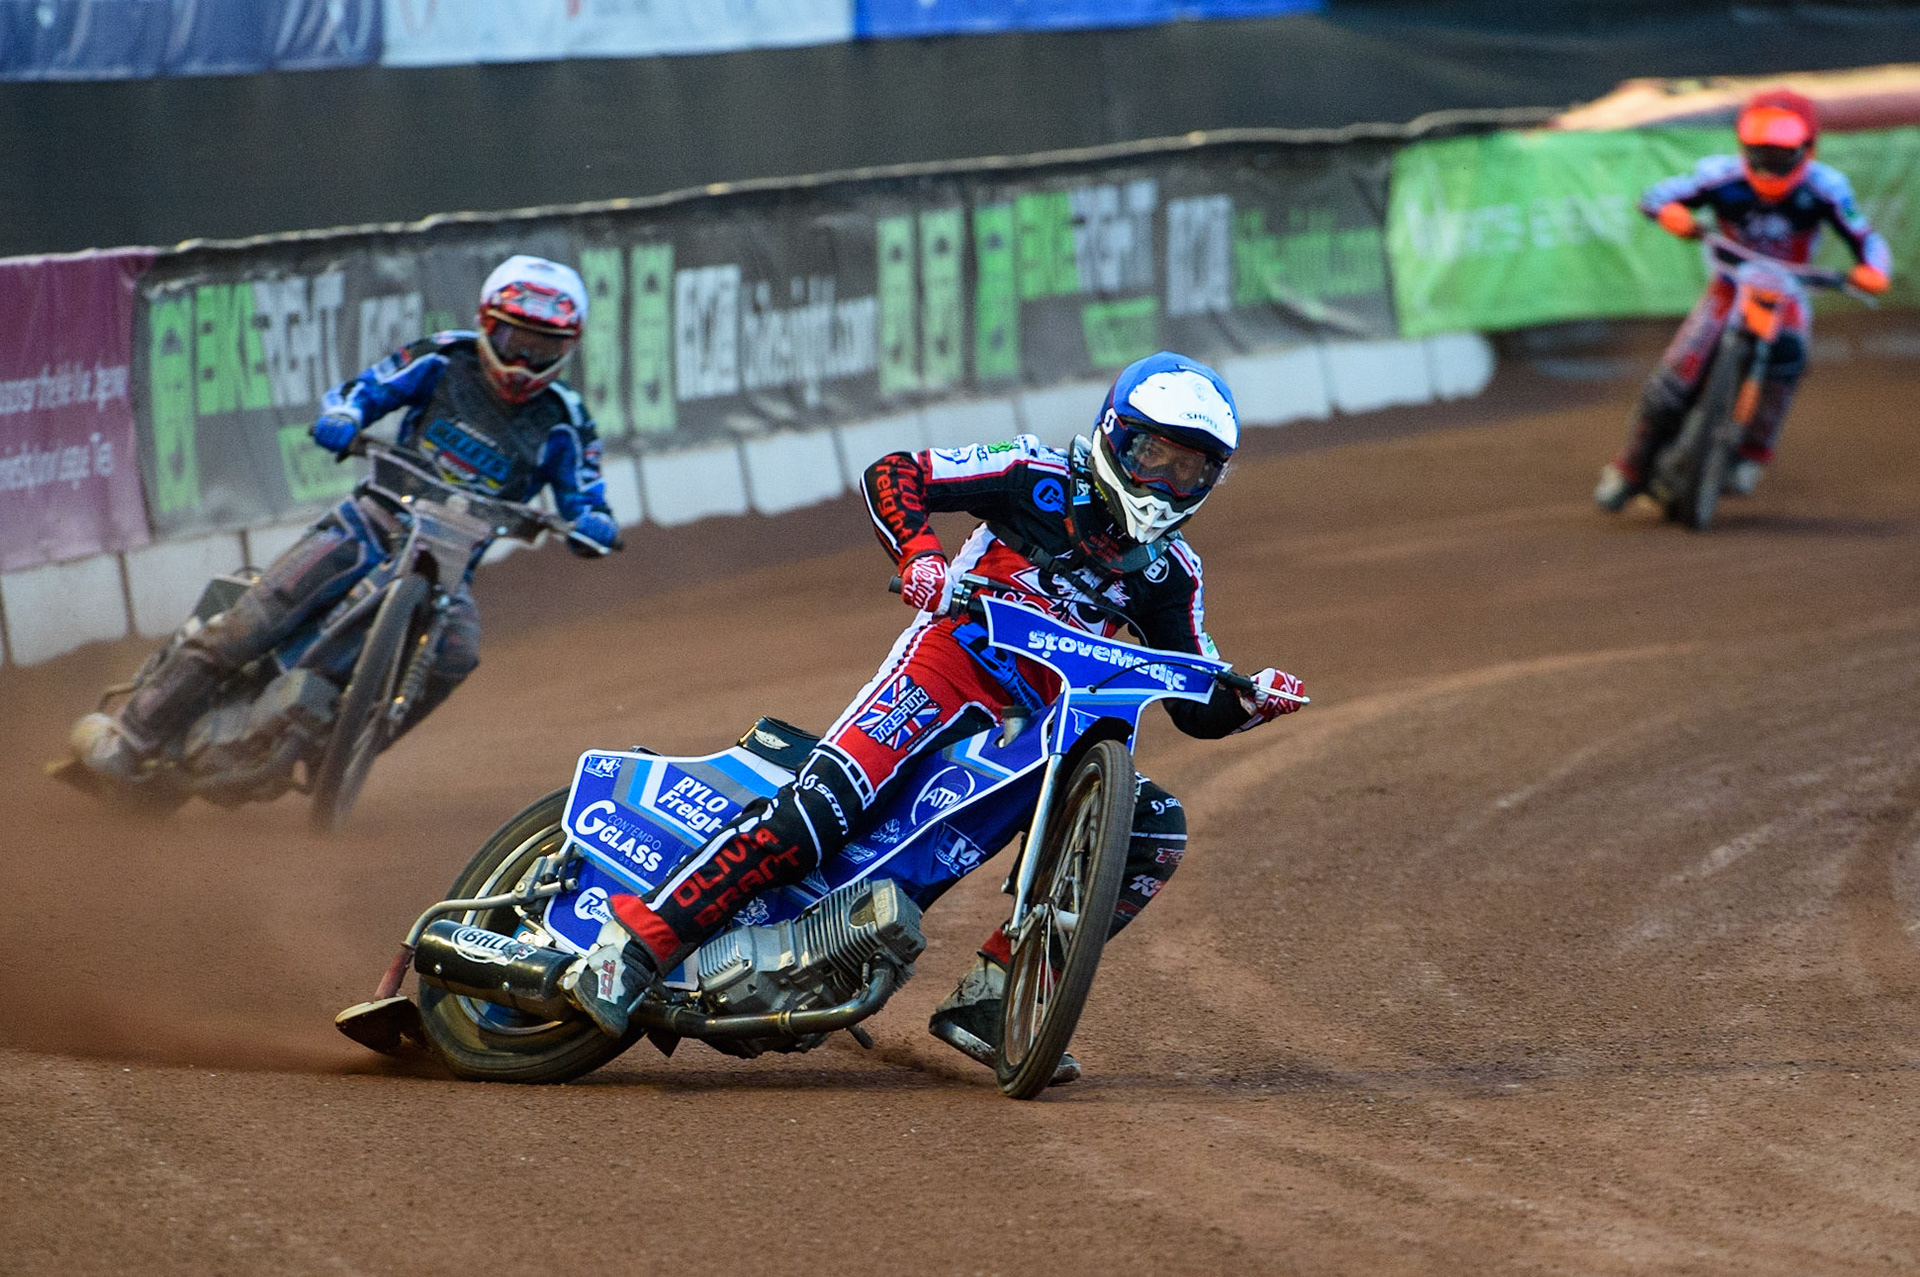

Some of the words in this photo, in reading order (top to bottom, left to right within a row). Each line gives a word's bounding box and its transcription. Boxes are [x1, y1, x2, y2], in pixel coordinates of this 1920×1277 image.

[867, 686, 930, 743] TRS-UK
[673, 776, 729, 813] RYLO
[598, 825, 663, 872] GLASS
[607, 814, 662, 850] CONTEMPO
